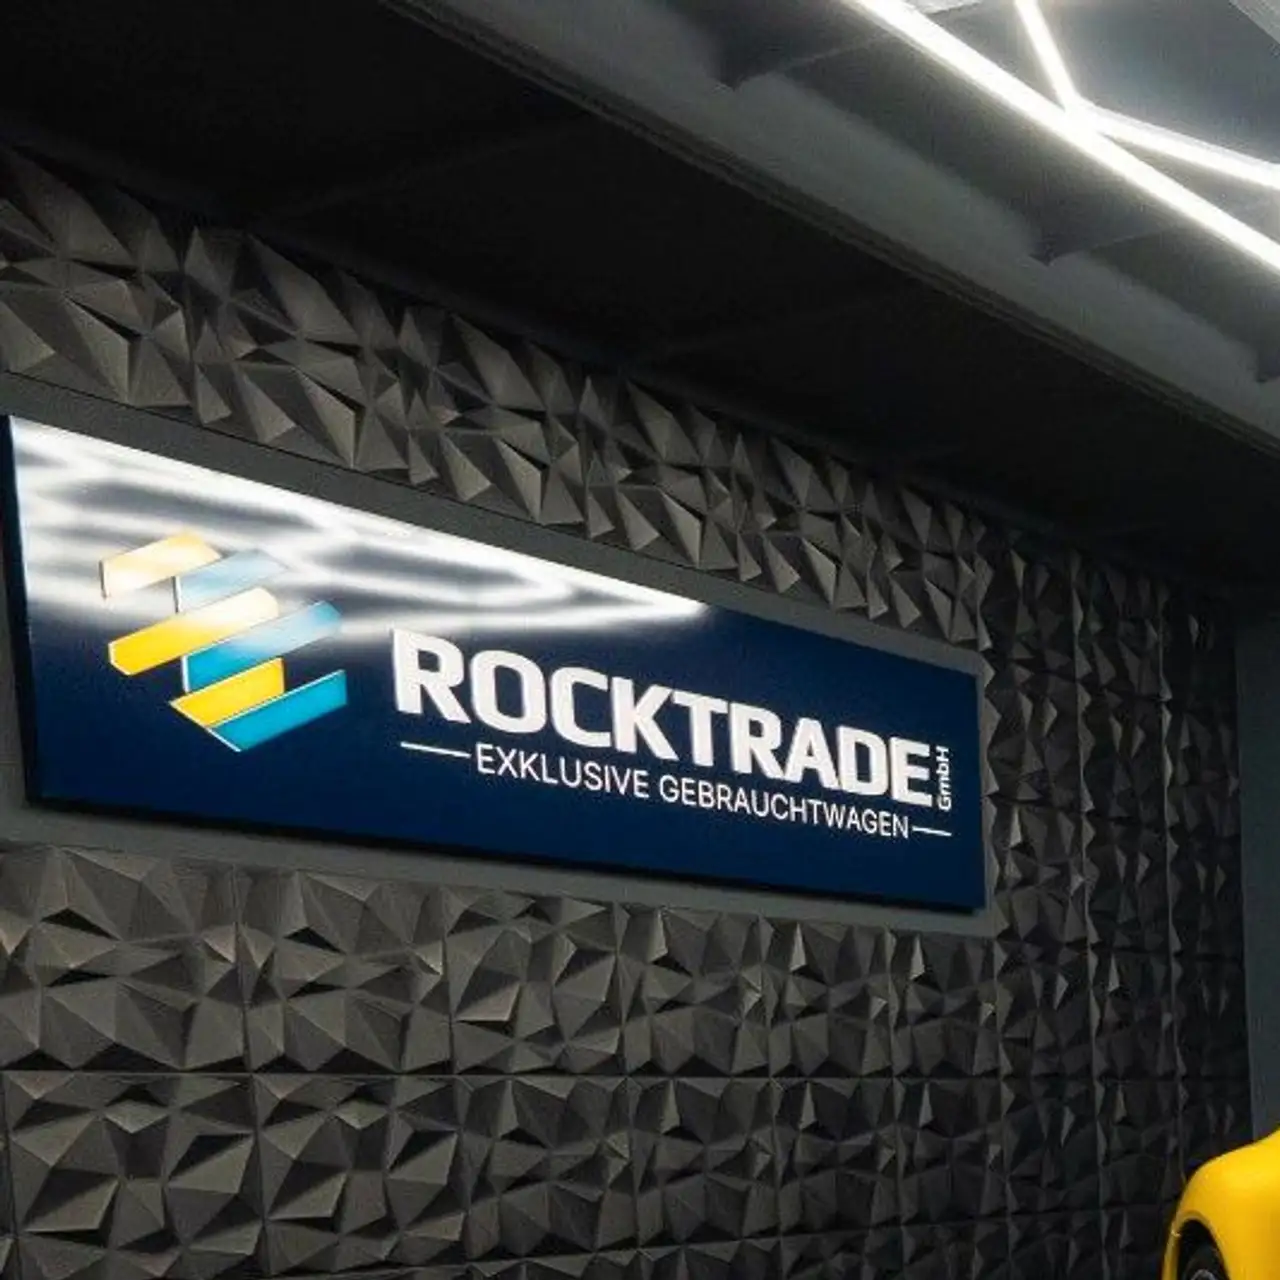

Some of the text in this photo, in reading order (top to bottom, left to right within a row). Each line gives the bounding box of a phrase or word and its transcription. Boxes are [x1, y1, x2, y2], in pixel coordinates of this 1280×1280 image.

[392, 629, 933, 806] ROCKTRADE
[475, 742, 909, 838] EXKLUSIVE GEBRAUCHTWAGEN
[935, 745, 951, 811] GmbH
